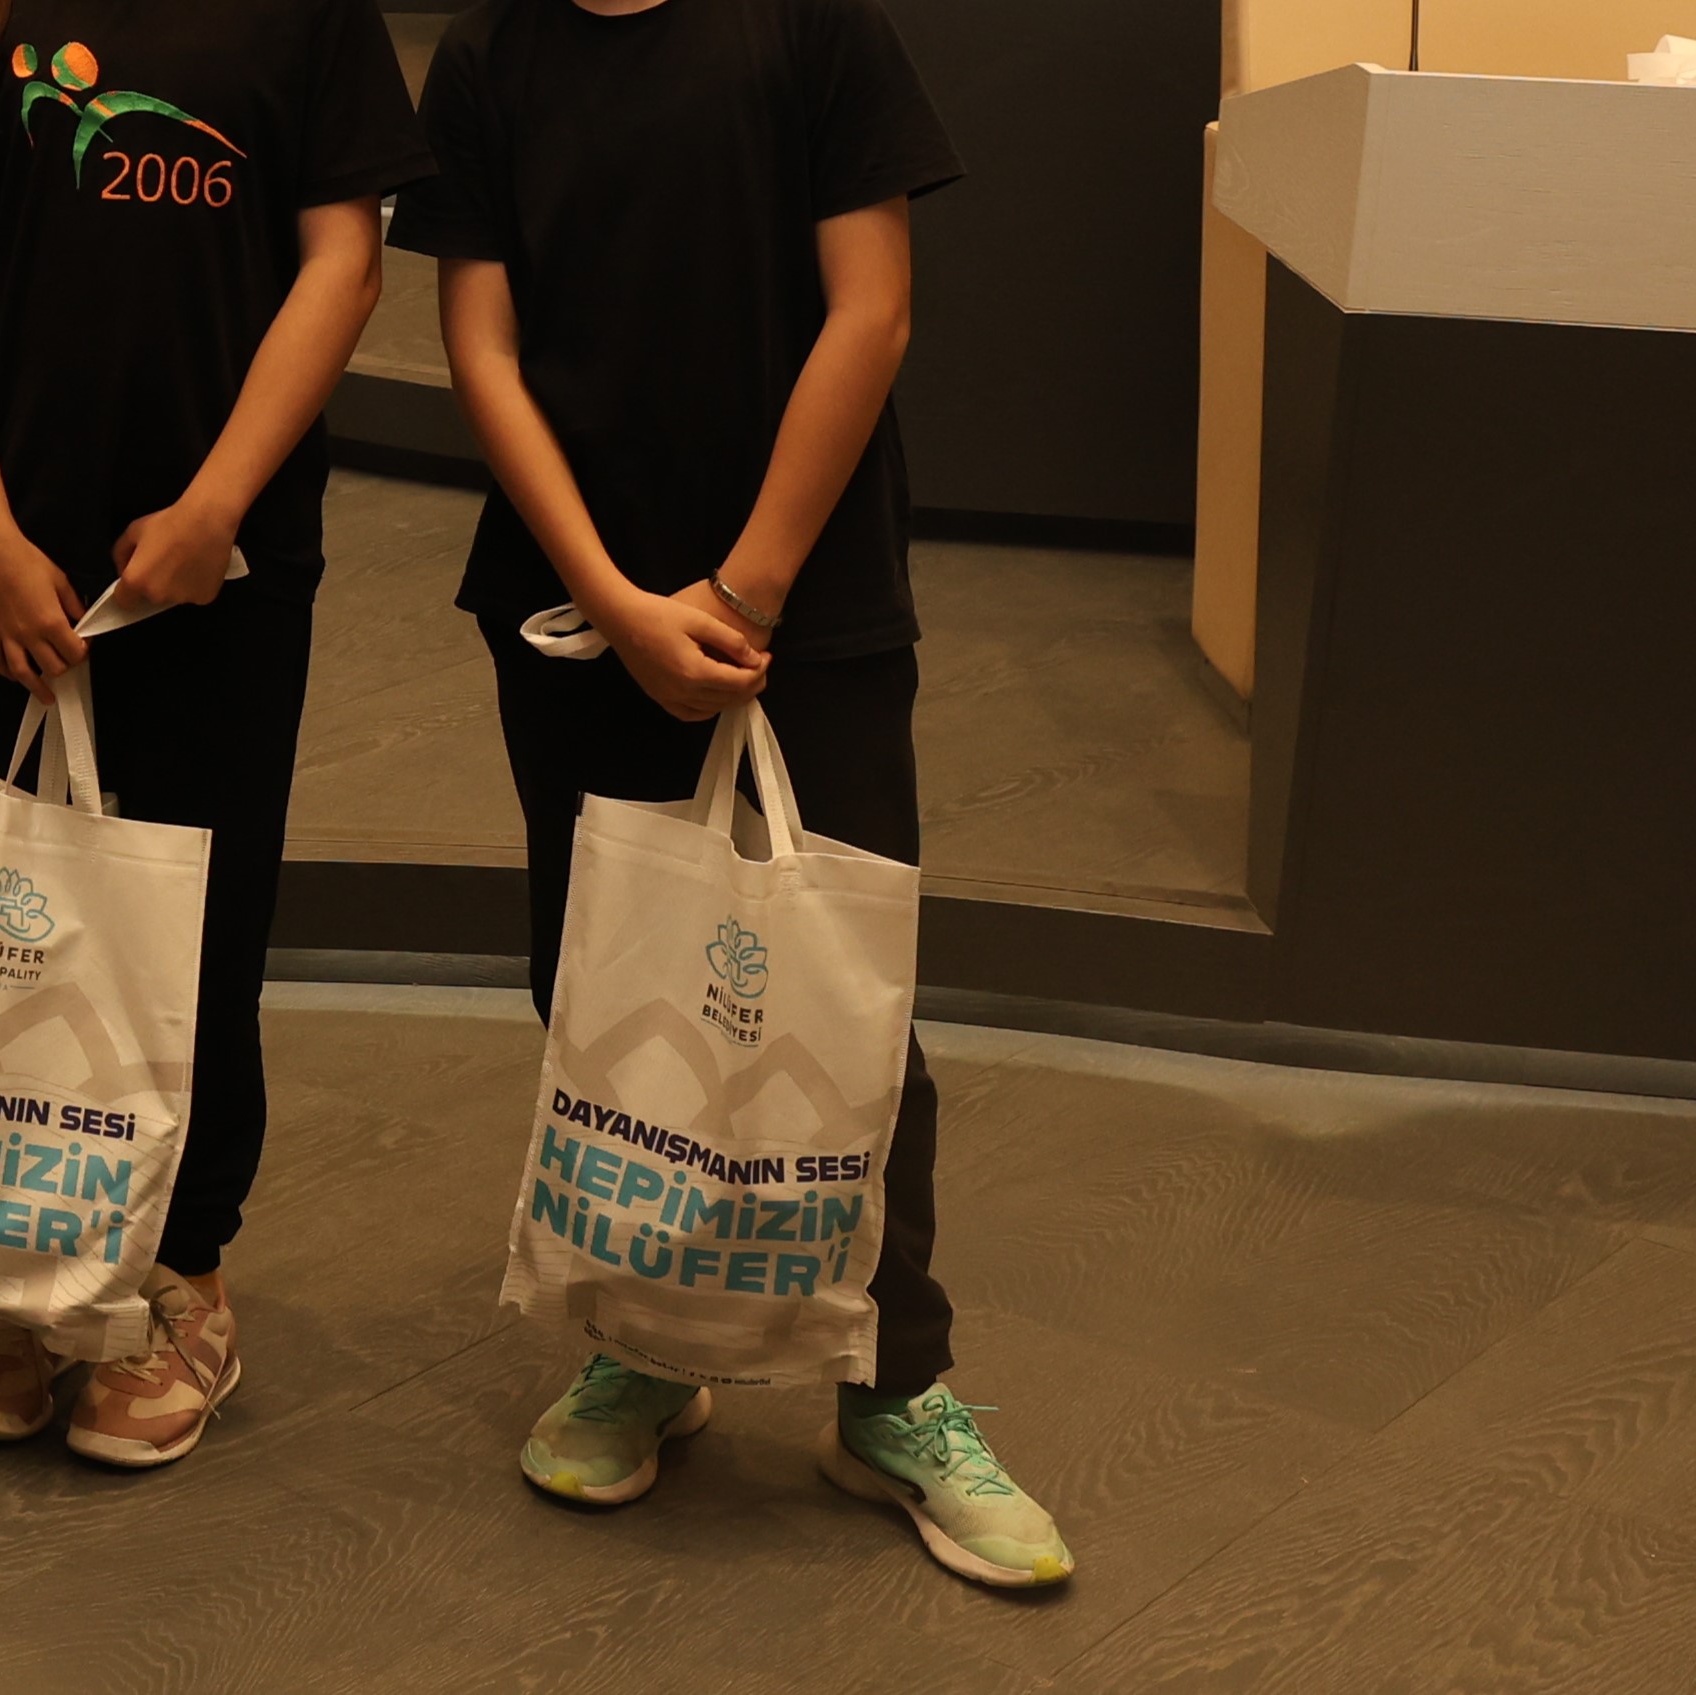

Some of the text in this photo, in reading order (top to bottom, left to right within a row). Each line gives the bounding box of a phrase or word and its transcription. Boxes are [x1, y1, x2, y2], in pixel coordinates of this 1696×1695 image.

[100, 150, 233, 207] 2006
[60, 1105, 136, 1141] SESİ
[552, 1087, 872, 1184] DAYANIŞMANIN SESİ
